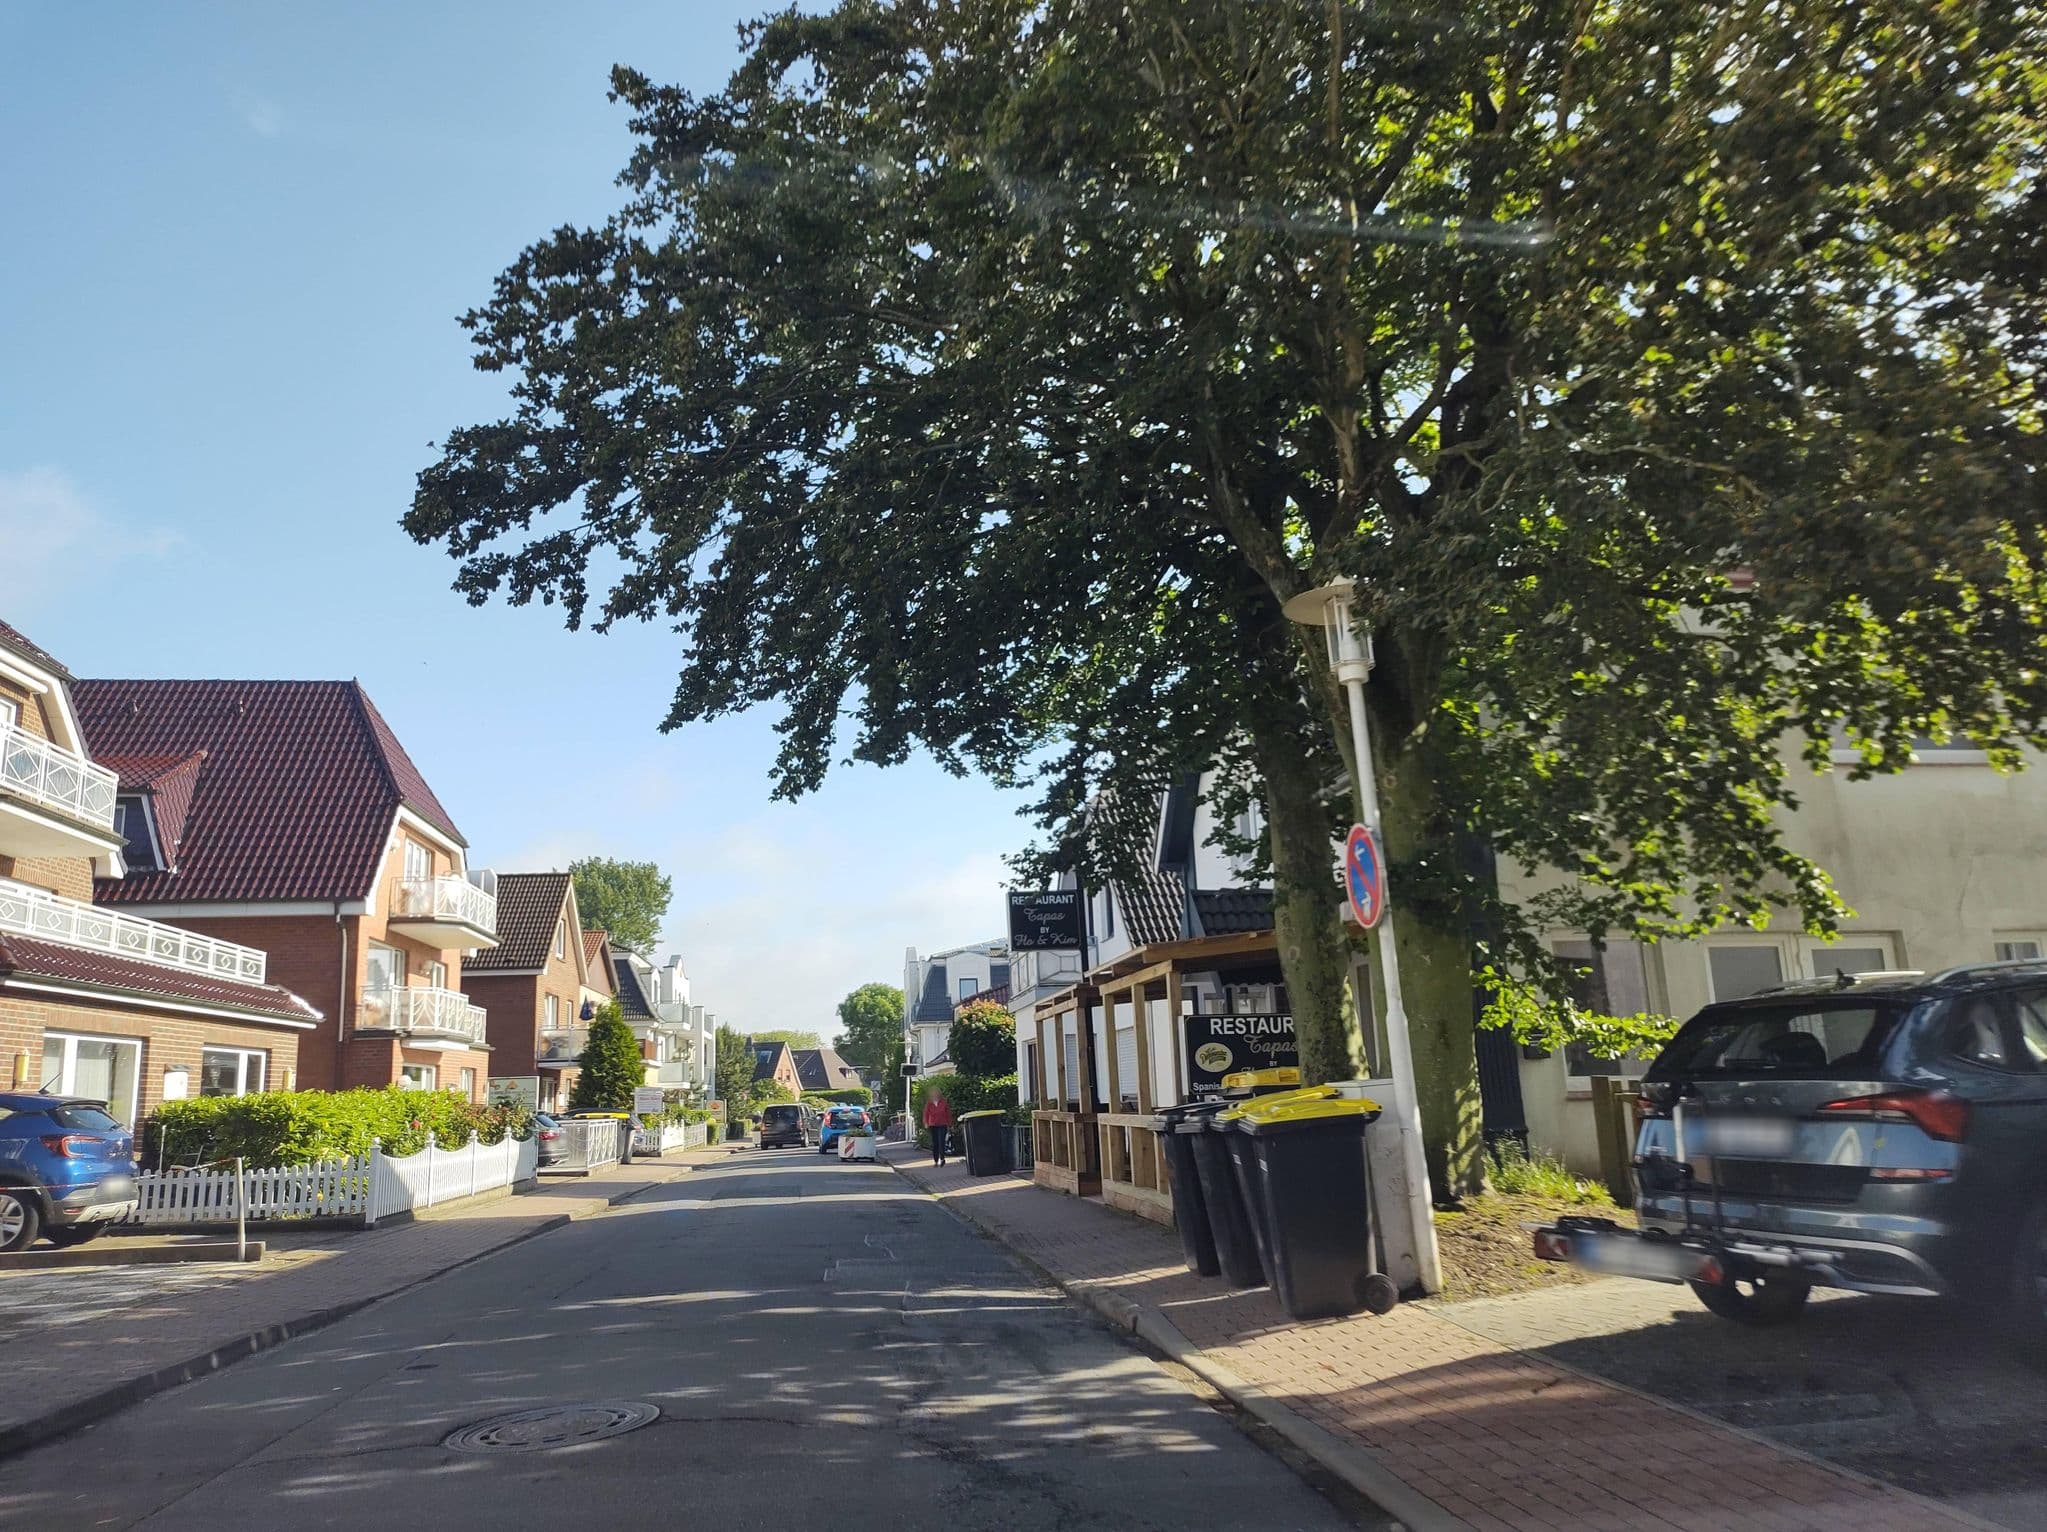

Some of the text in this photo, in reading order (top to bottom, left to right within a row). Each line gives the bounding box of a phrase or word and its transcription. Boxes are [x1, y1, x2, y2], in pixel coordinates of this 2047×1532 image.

[1011, 894, 1075, 906] REAURANT
[1040, 926, 1050, 934] BY
[1037, 935, 1048, 945] &
[1049, 932, 1078, 945] Kim
[1210, 1017, 1295, 1035] RESTAUR
[1192, 1082, 1221, 1093] Spanis
